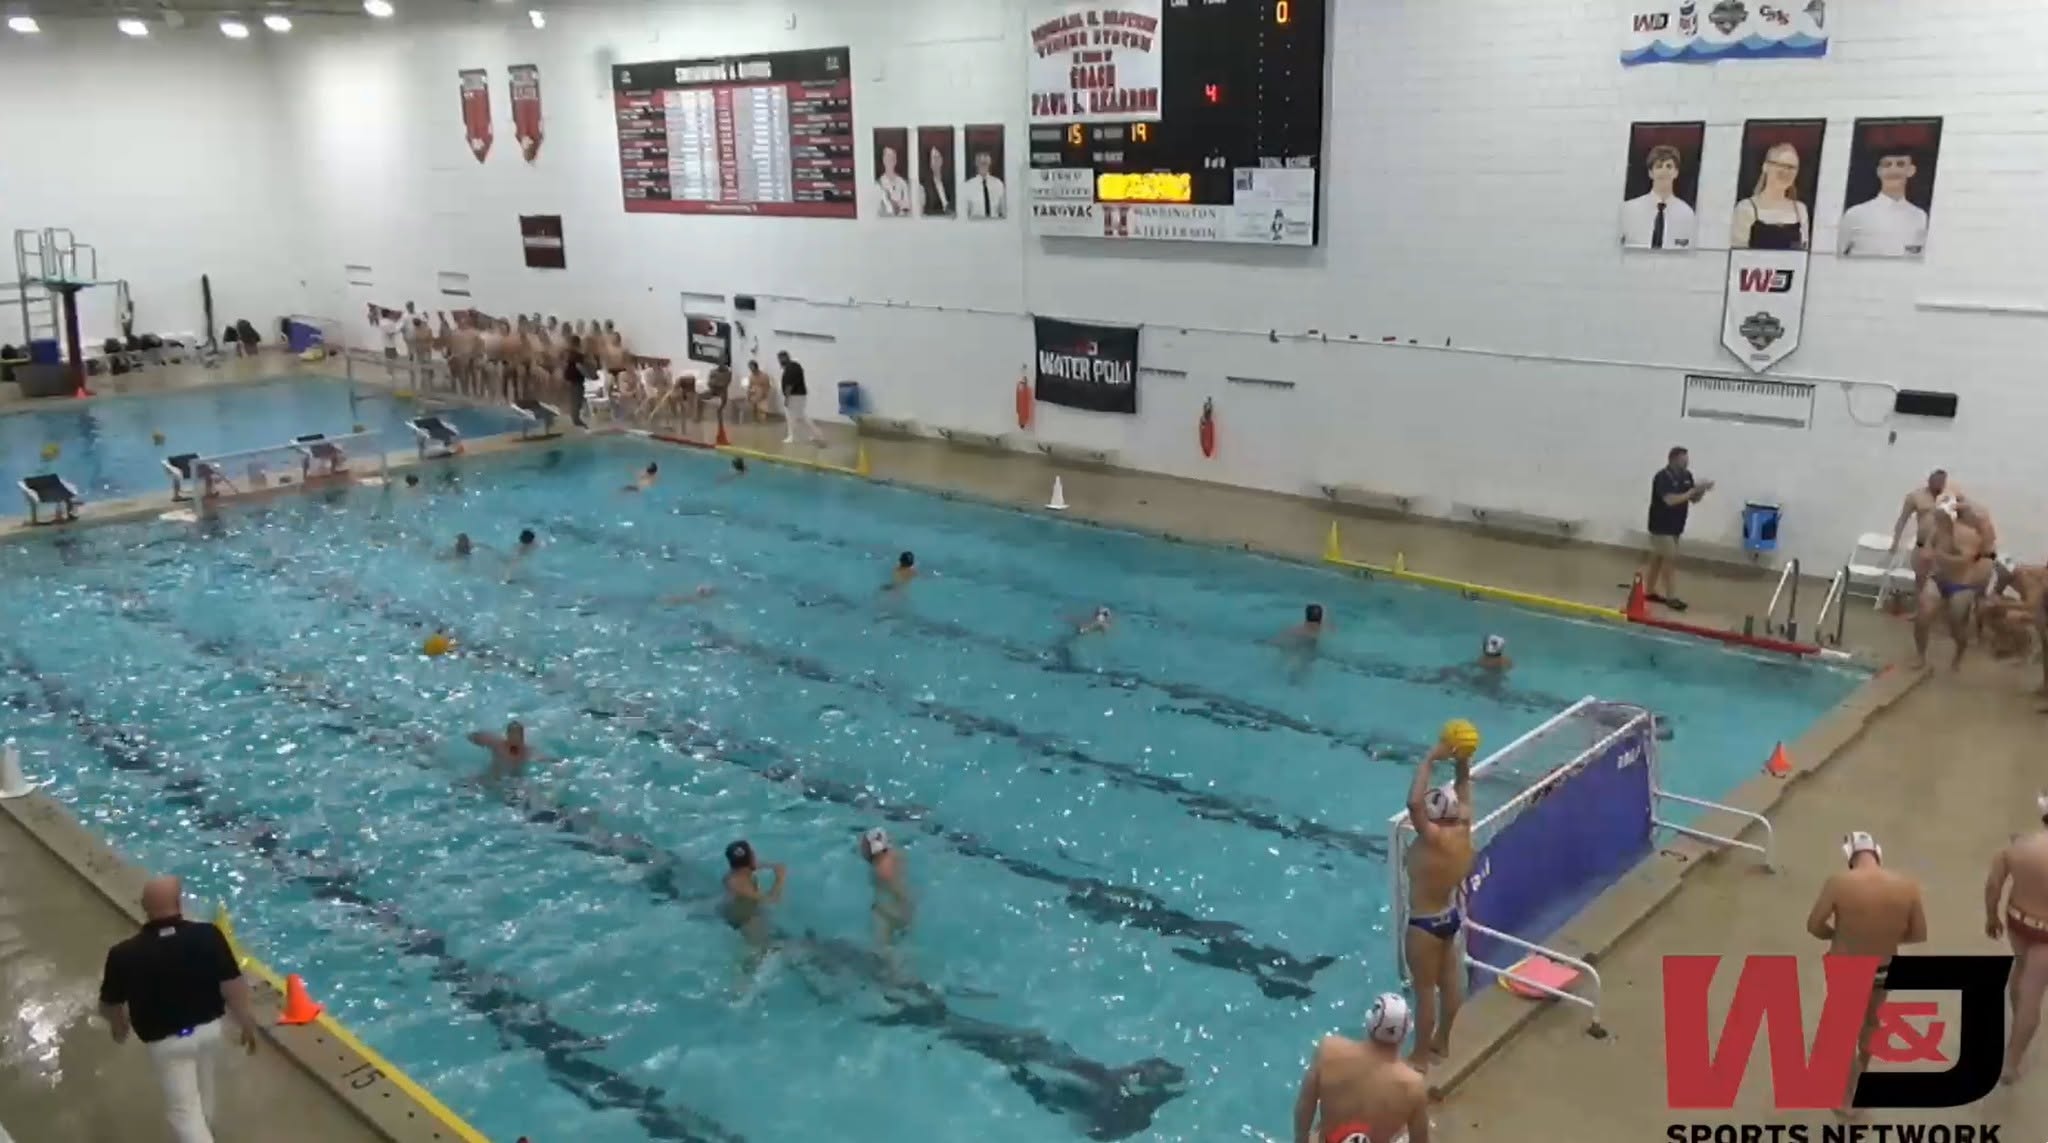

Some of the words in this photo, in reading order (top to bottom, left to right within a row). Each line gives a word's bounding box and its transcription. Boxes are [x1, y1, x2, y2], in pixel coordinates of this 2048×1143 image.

[1205, 84, 1217, 102] 4
[1067, 124, 1082, 144] 15
[1131, 123, 1147, 142] 19
[1038, 350, 1091, 381] WATER
[341, 1062, 386, 1090] 15
